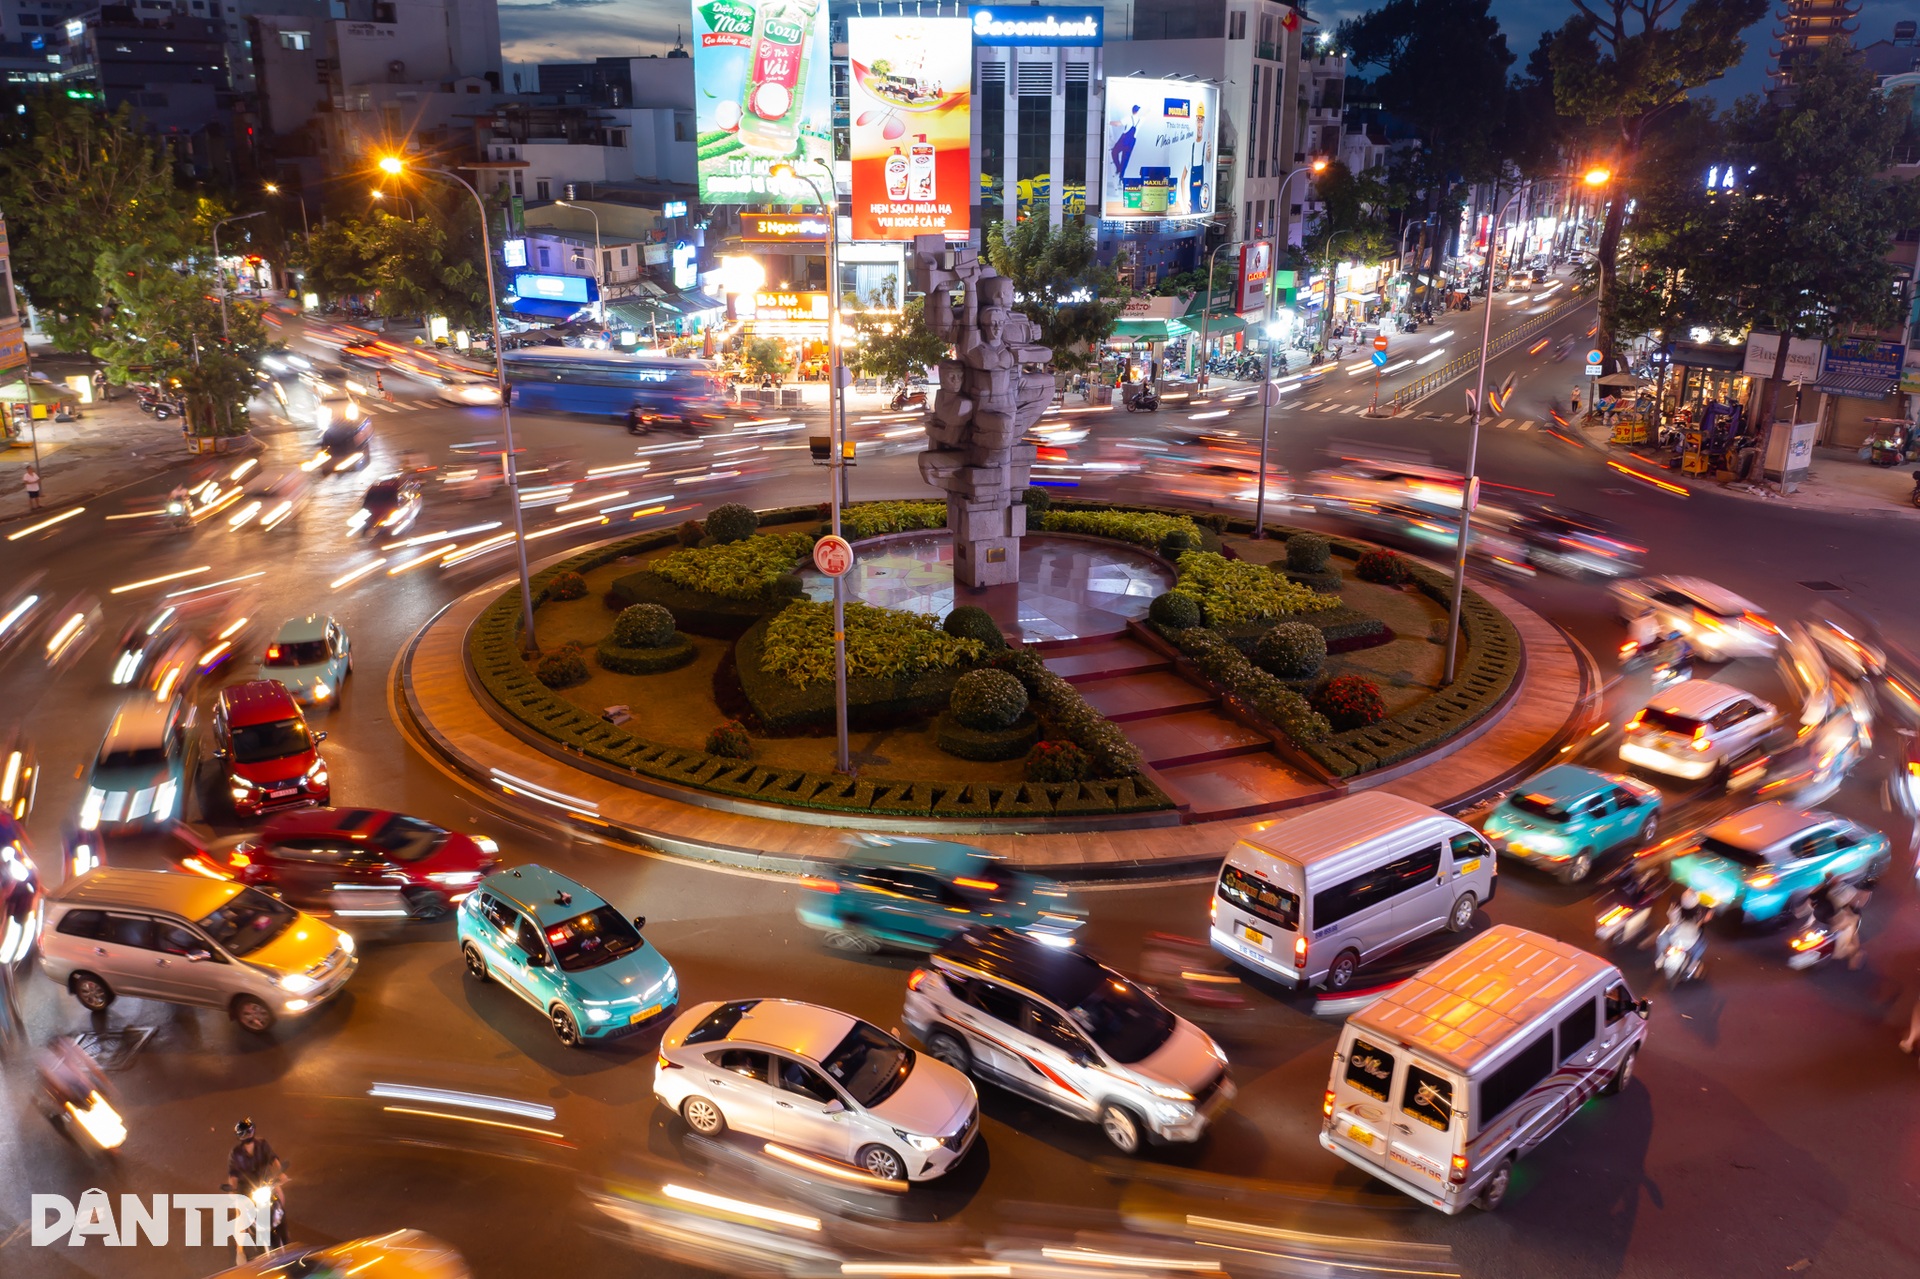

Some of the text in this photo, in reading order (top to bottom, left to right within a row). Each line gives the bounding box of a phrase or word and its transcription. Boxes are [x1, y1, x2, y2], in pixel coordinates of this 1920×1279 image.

[712, 2, 733, 14] Diện
[714, 14, 751, 33] Mới
[973, 11, 1098, 36] Sacombank
[765, 21, 800, 43] Cozy
[774, 48, 789, 57] Trà
[763, 58, 789, 75] Vải
[870, 202, 953, 215] HẸN SẠCH MÙA HẠ
[758, 221, 767, 234] 3
[877, 217, 894, 228] VUI
[757, 293, 799, 307] Bò Né
